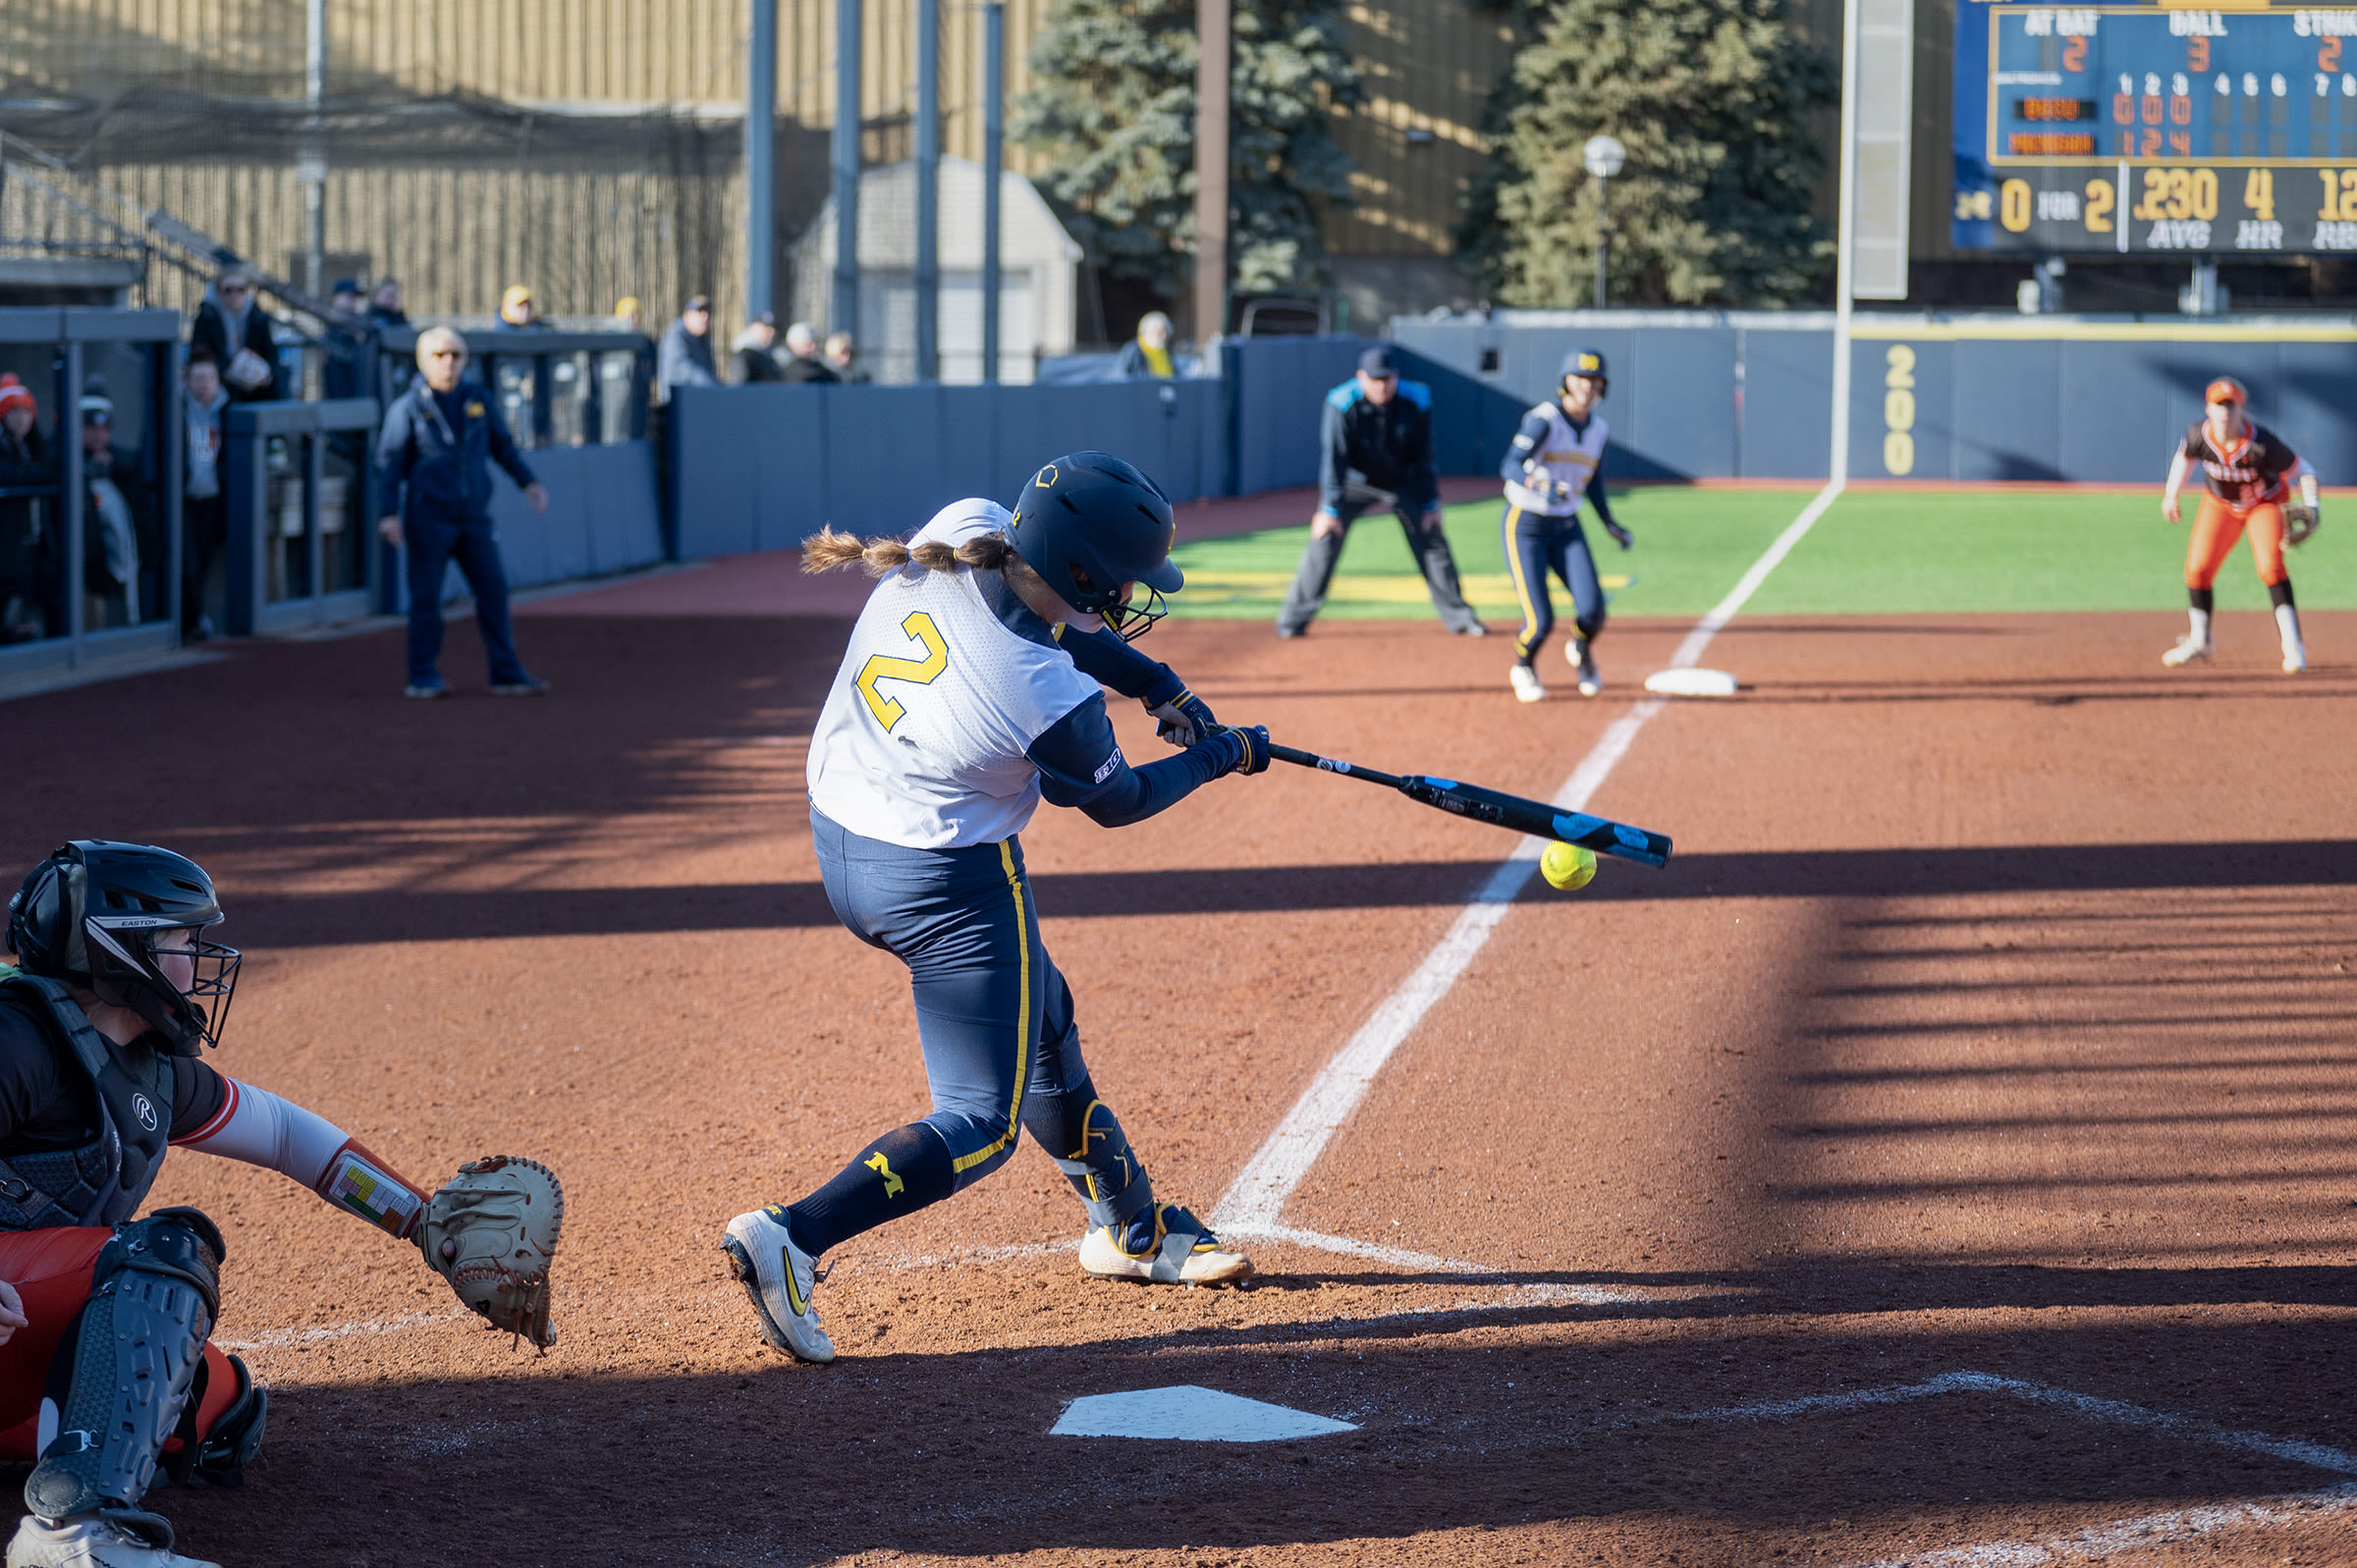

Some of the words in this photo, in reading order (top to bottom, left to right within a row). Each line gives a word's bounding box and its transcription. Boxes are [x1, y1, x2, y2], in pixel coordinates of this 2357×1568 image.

[2168, 9, 2228, 37] BALL
[2063, 34, 2088, 73] 2
[2188, 34, 2210, 73] 3
[2318, 34, 2342, 73] 2
[2314, 72, 2330, 96] 7
[2001, 178, 2031, 233] 0
[2085, 179, 2114, 233] 2
[2133, 168, 2219, 221] .230
[2243, 168, 2275, 221] 4
[2146, 219, 2212, 248] AVG
[2234, 219, 2283, 249] HR
[1884, 344, 1916, 476] 200
[855, 611, 950, 734] 2
[863, 1151, 904, 1200] M
